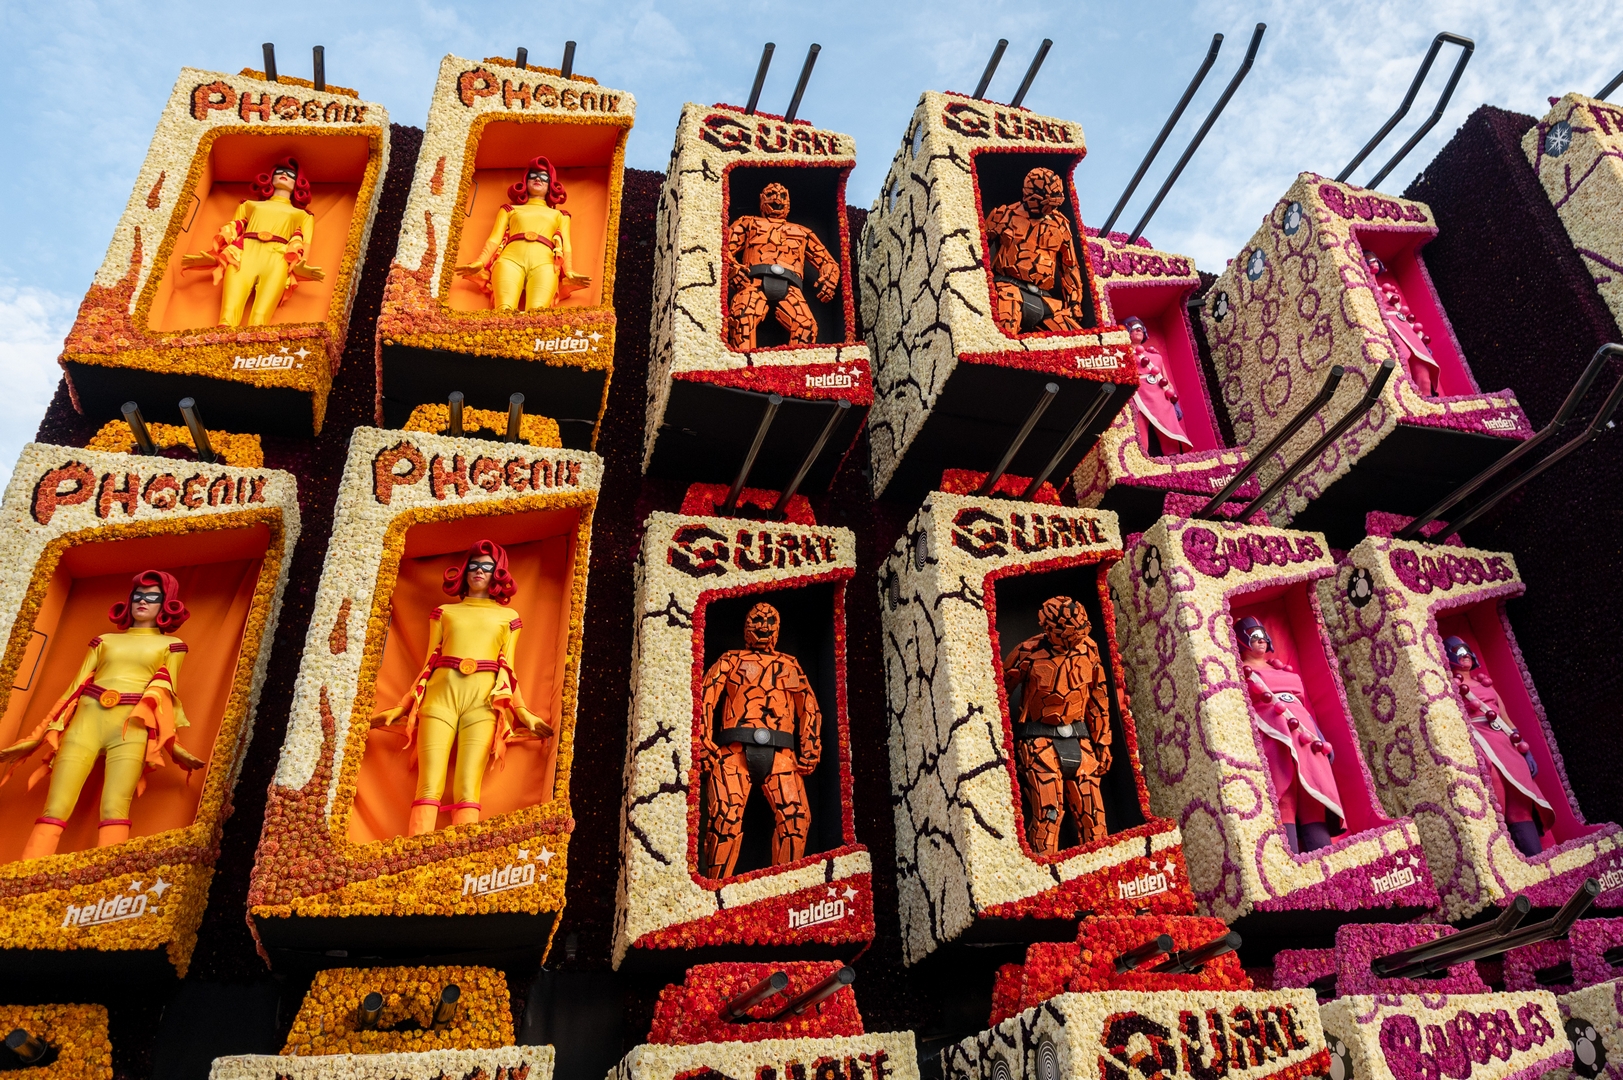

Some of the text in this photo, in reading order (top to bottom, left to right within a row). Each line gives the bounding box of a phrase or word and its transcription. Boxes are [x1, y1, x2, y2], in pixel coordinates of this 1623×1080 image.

[190, 81, 368, 123] PHOENIX
[457, 67, 620, 112] PHOENIX
[1318, 184, 1427, 222] BUBBLES
[534, 337, 589, 354] helden
[1075, 355, 1117, 369] helden
[232, 354, 294, 371] helden
[805, 374, 851, 388] helden
[1482, 417, 1516, 430] helden
[373, 441, 580, 505] PHOENIX
[1209, 474, 1235, 488] held
[31, 459, 266, 525] PHOENIX
[1182, 526, 1323, 578] BUBBLES
[1389, 547, 1514, 594] BUBBLES
[462, 863, 536, 896] helden
[1117, 873, 1167, 899] helden
[1371, 866, 1415, 894] helden
[62, 894, 147, 927] helden
[788, 898, 844, 928] helden
[1379, 1002, 1555, 1080] BUBBLES
